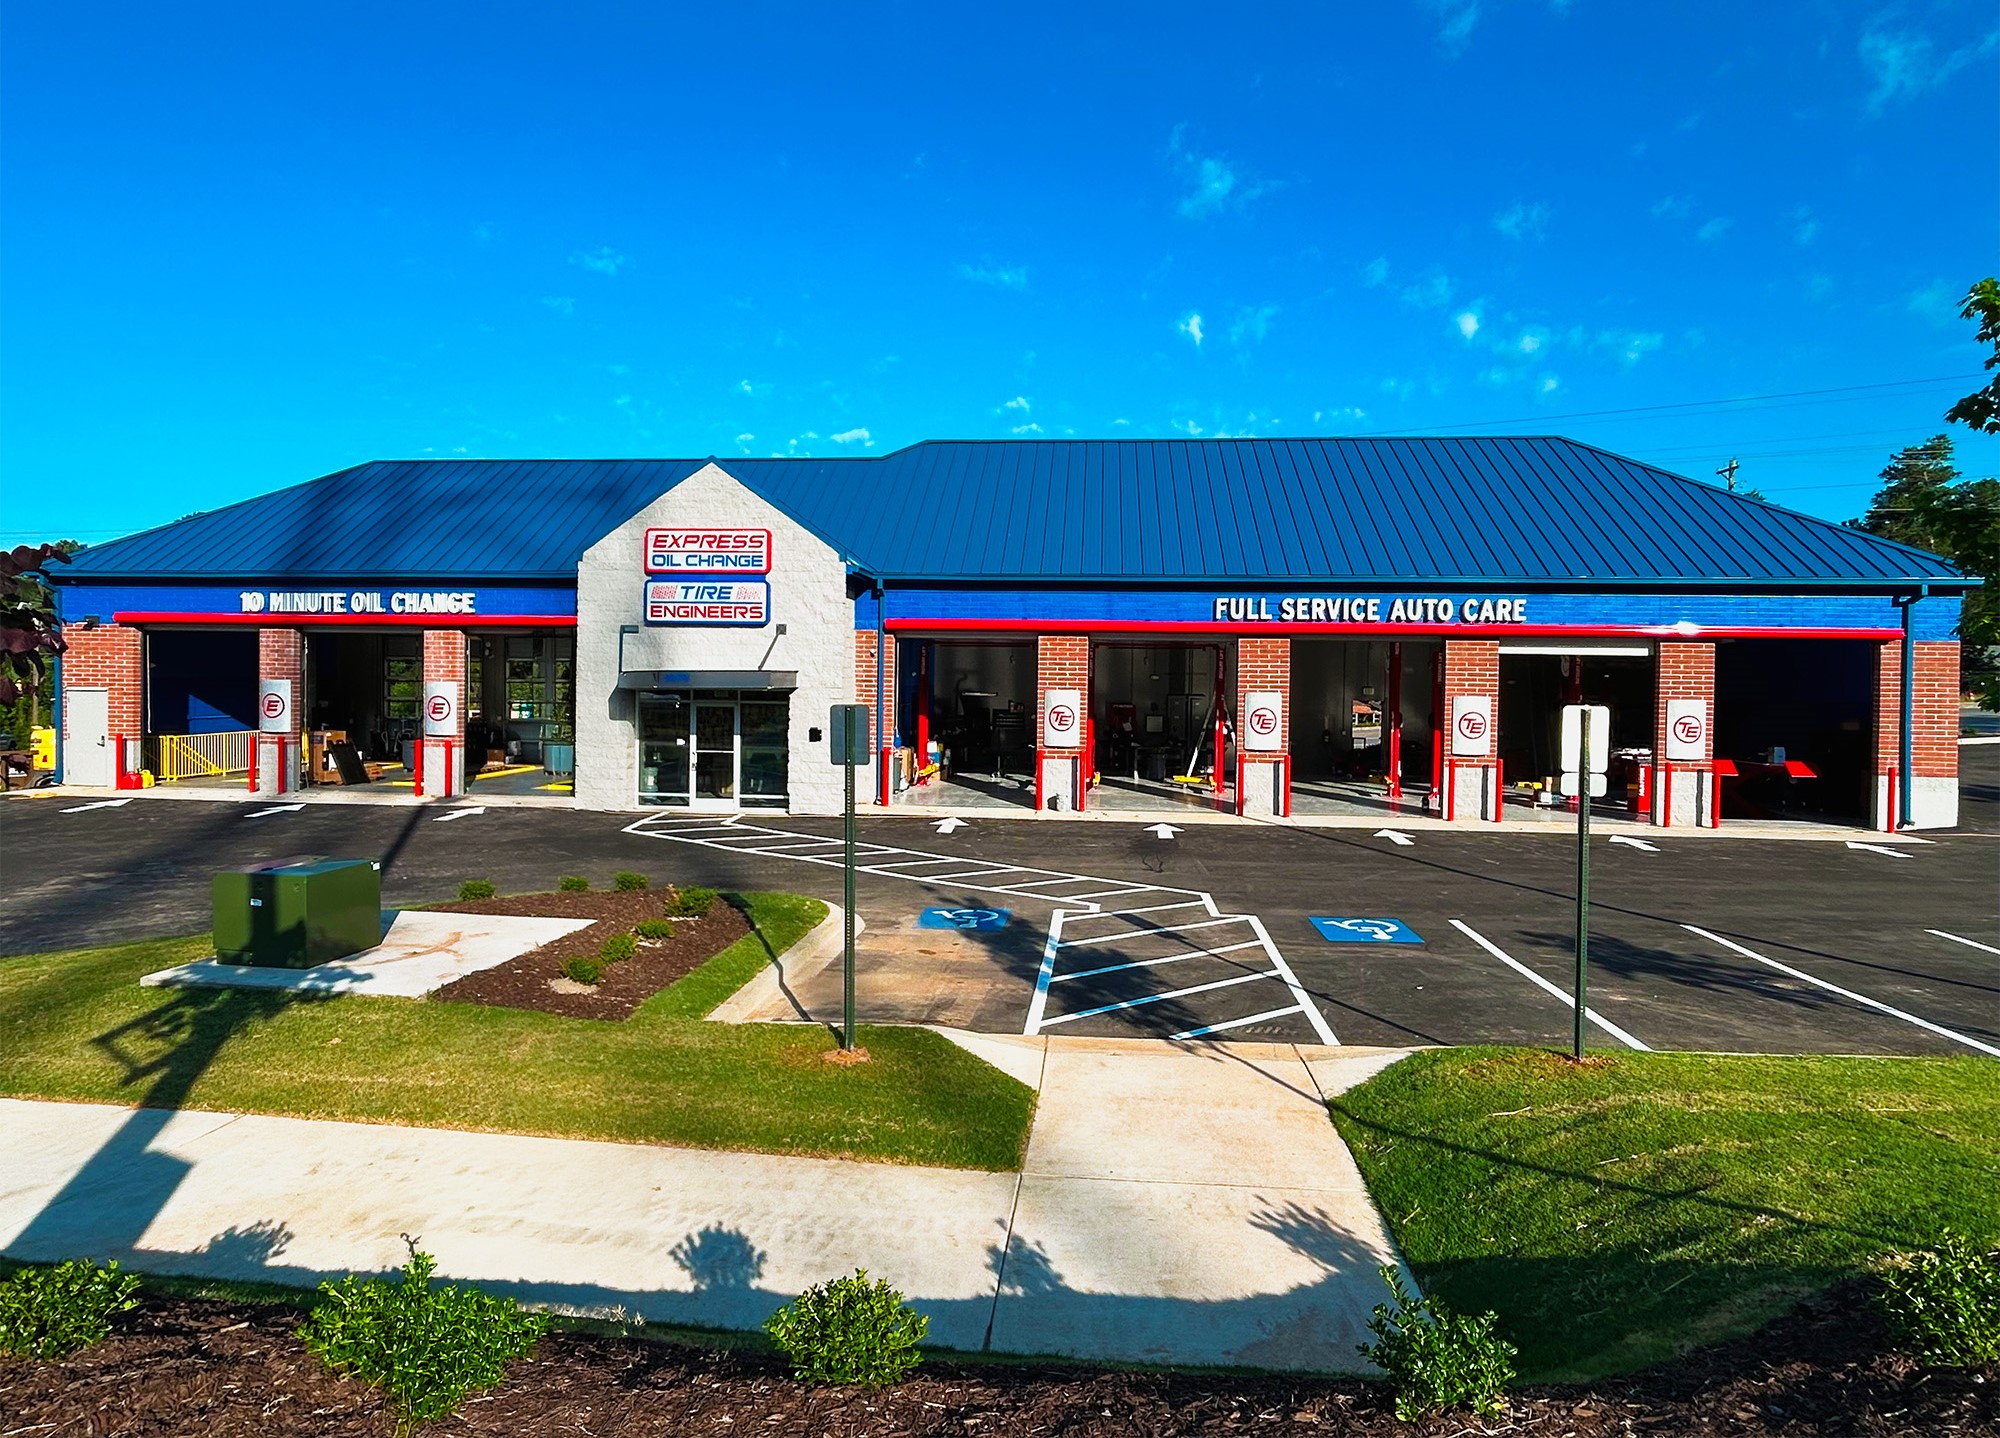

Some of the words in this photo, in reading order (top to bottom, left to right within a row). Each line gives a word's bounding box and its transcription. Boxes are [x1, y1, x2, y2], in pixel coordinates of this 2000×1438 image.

[652, 534, 765, 549] EXPRESS
[652, 554, 682, 567] OIL
[685, 554, 763, 567] CHANGE
[680, 585, 733, 600] TIRE
[240, 592, 265, 612] 10
[269, 592, 347, 613] MINUTE
[350, 592, 386, 613] OIL
[391, 592, 476, 613] CHANGE
[1215, 597, 1273, 620] FULL
[1281, 597, 1380, 621] SERVICE
[1390, 598, 1454, 621] AUTO
[1463, 599, 1527, 621] CARE
[650, 605, 763, 619] ENGINEERS
[266, 700, 280, 712] E
[431, 703, 446, 715] E
[1052, 711, 1072, 726] TE
[1254, 714, 1274, 729] TE
[1463, 718, 1484, 734] TE
[1679, 722, 1700, 738] TE
